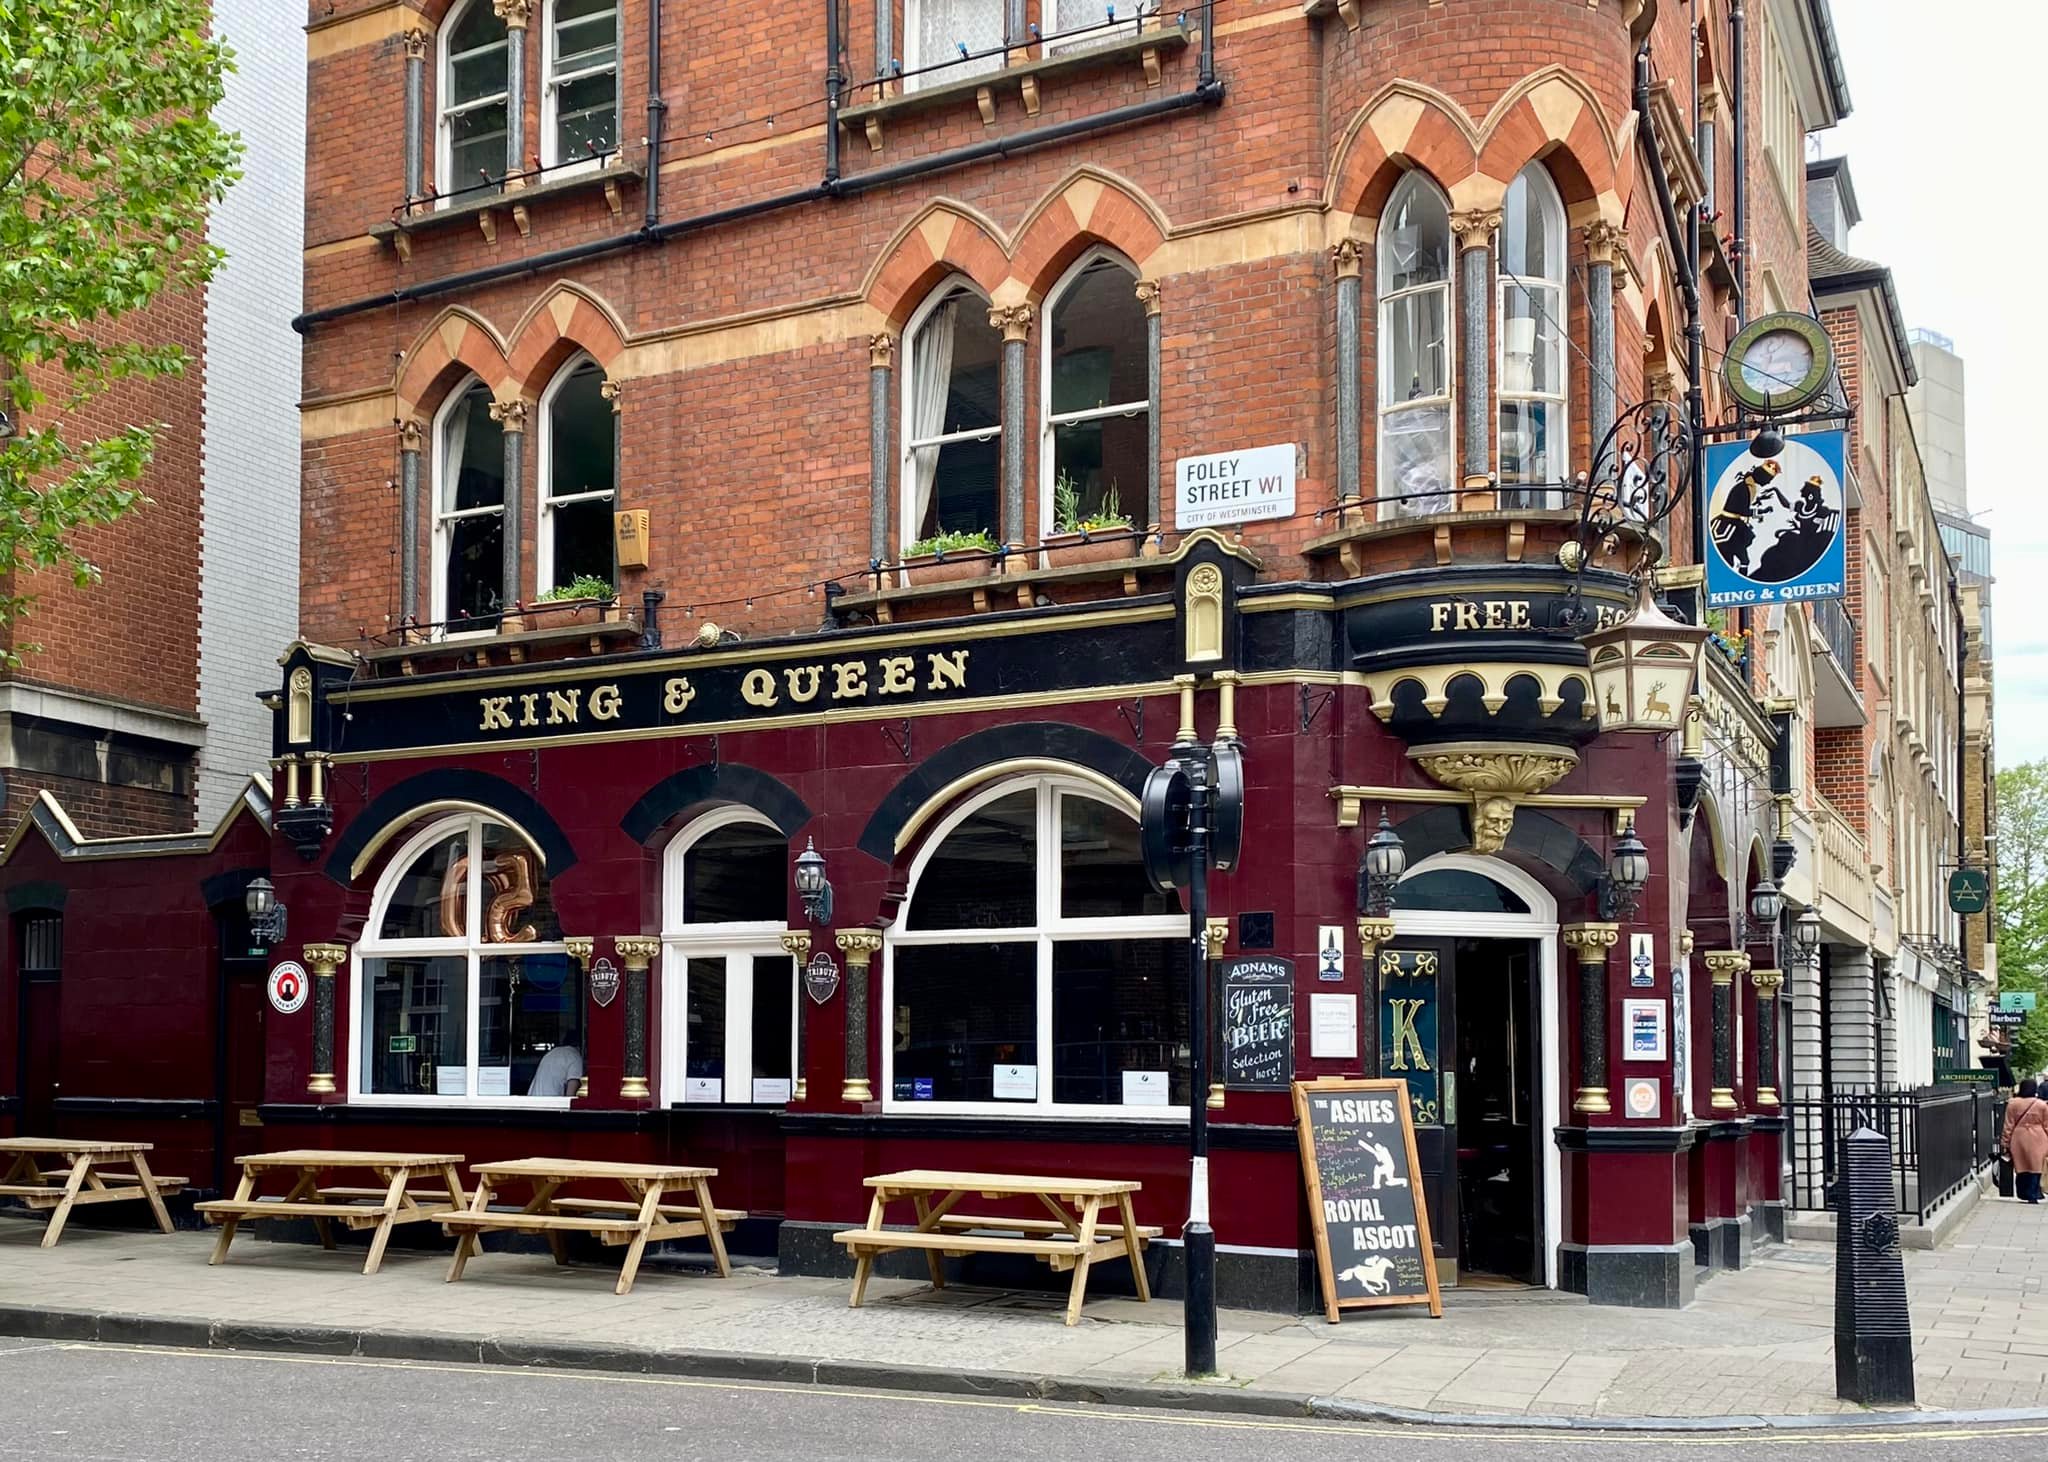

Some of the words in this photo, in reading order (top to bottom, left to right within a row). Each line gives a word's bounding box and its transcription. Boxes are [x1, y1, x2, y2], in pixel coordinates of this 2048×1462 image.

[1761, 316, 1816, 338] COMBE
[1810, 343, 1826, 378] REID
[1187, 459, 1240, 482] FOLEY
[1187, 479, 1252, 504] STREET
[1258, 476, 1283, 496] W1
[1187, 513, 1205, 524] CITY
[1207, 511, 1218, 521] OF
[1219, 504, 1277, 519] WESTMINSTER
[1710, 587, 1756, 604] KING
[1760, 587, 1775, 600] &
[1779, 582, 1840, 599] QUEEN
[1430, 600, 1531, 632] FREE
[479, 684, 622, 731] KING
[664, 676, 695, 714] &
[740, 649, 970, 708] QUEEN
[591, 972, 618, 981] TRIBUTE
[808, 968, 838, 977] TRIBUTE
[1230, 962, 1286, 978] ADNAMS
[1229, 988, 1273, 1019] Gluten
[1990, 1014, 2022, 1023] Barbers
[1230, 1021, 1286, 1051] BEER
[1389, 999, 1431, 1071] K
[1232, 1049, 1283, 1070] Selection
[1255, 1062, 1281, 1080] here!
[1314, 1099, 1328, 1109] THE
[1330, 1099, 1395, 1125] ASHES
[1323, 1197, 1384, 1223] ROYAL
[1353, 1225, 1417, 1250] ASCOT
